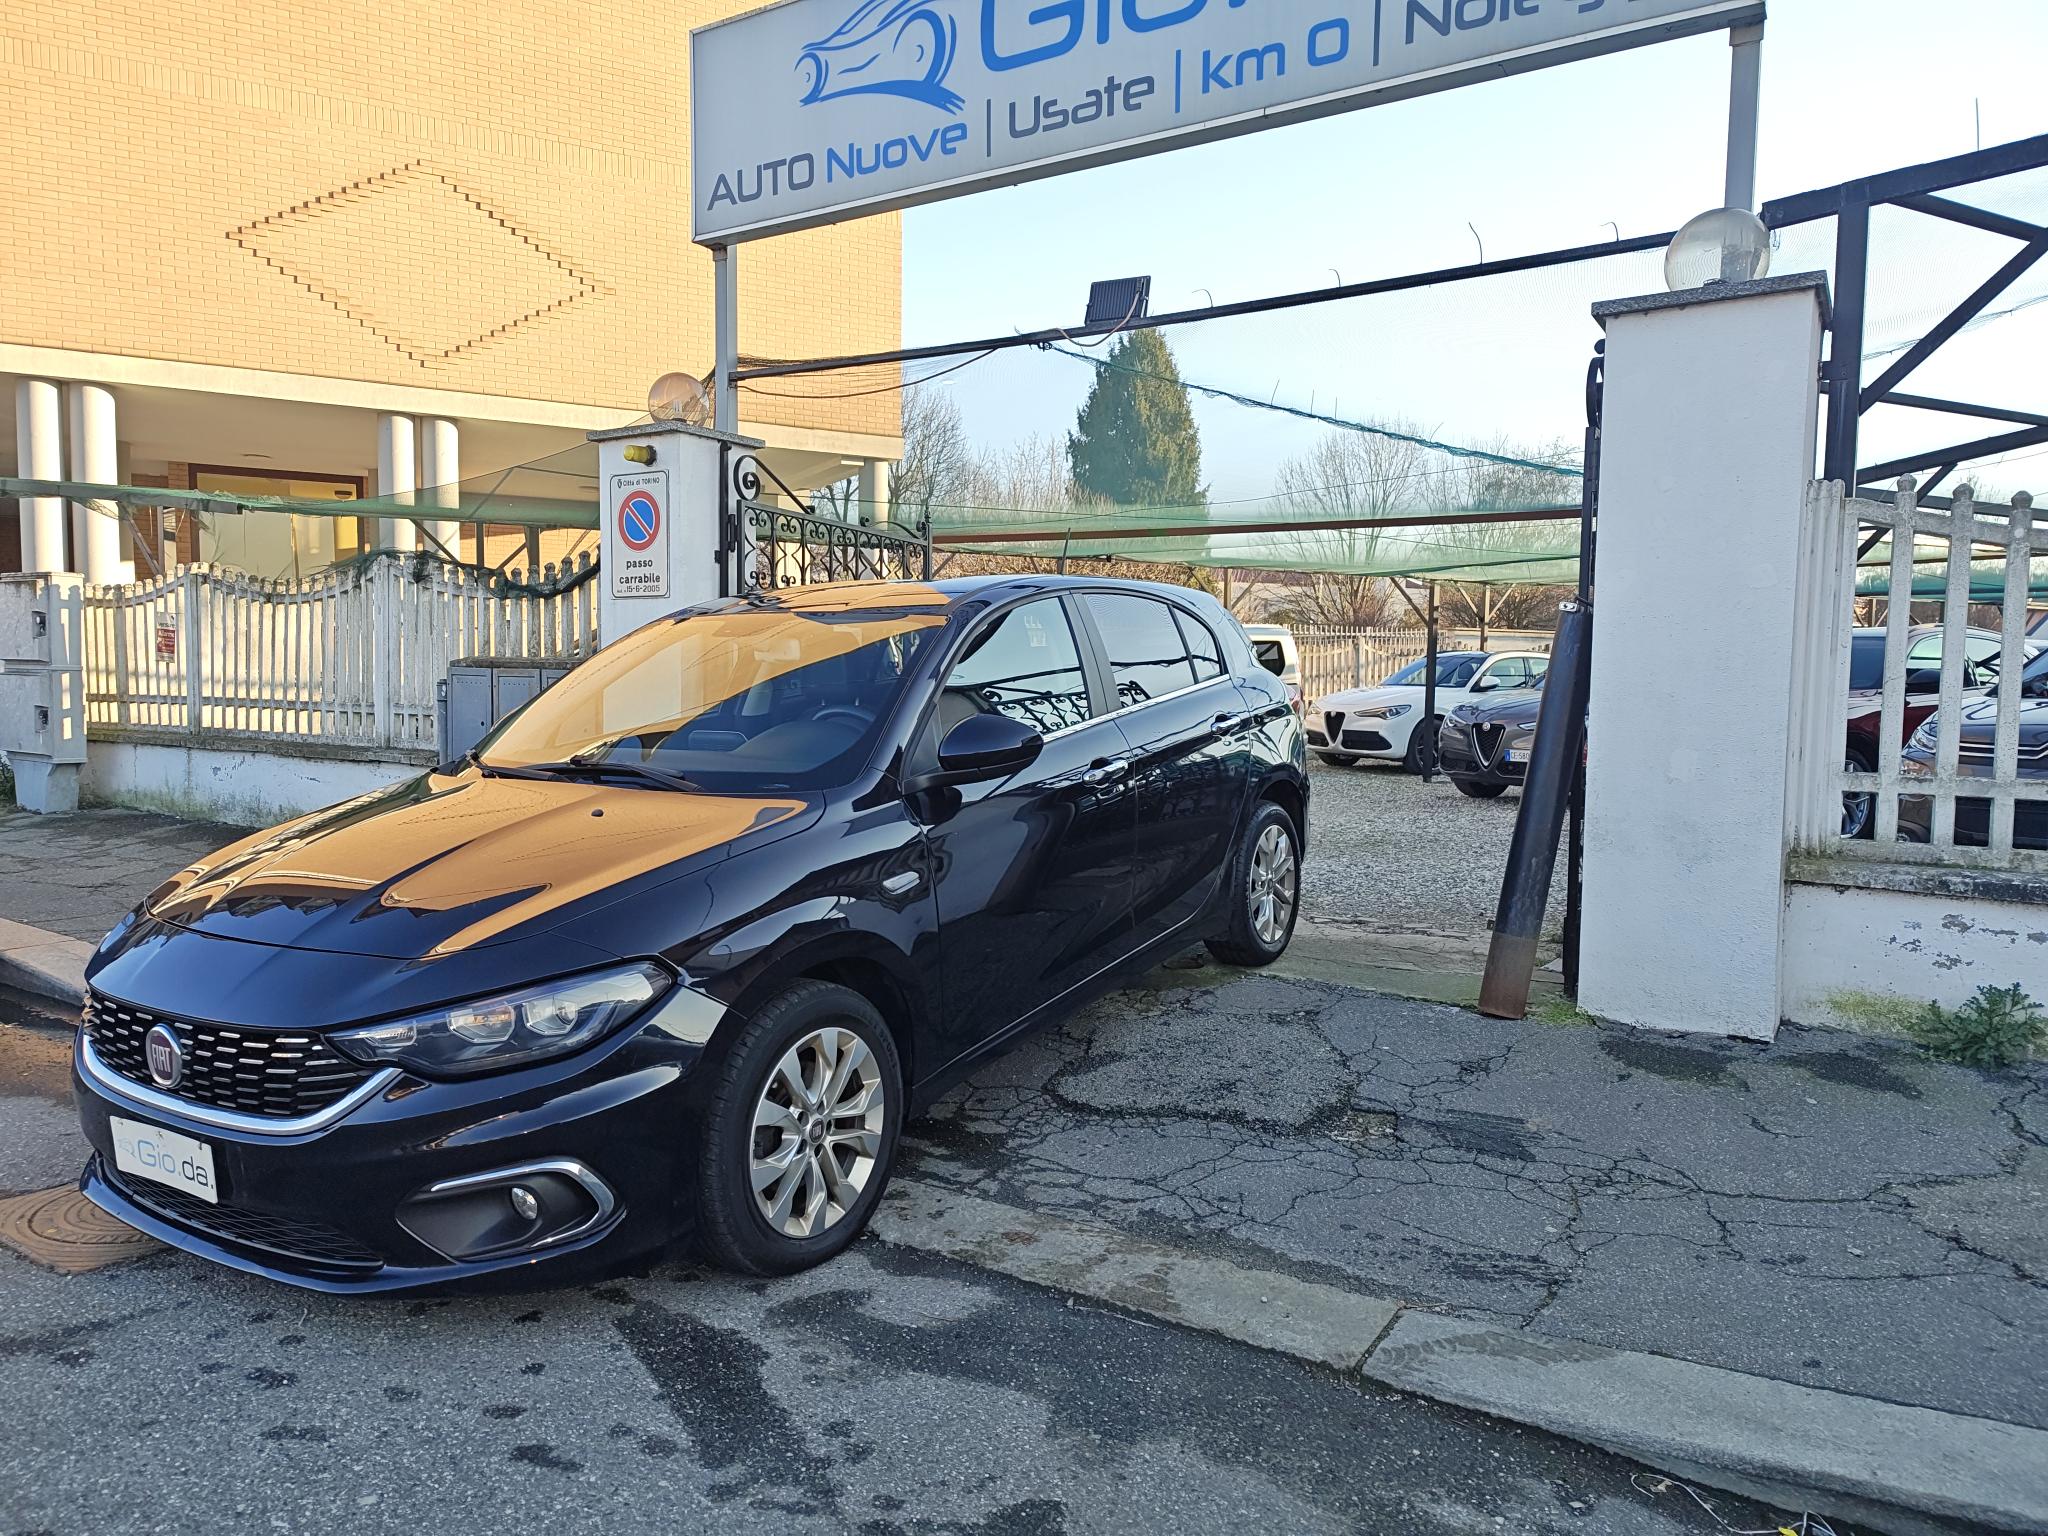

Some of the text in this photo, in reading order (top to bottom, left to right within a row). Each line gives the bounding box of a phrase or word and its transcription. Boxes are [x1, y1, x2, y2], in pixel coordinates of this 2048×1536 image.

[707, 152, 815, 212] AUTO
[826, 122, 968, 184] Nuove
[1008, 75, 1156, 140] Usate
[1201, 41, 1287, 95] km
[641, 477, 660, 485] TORINO
[626, 559, 653, 570] passo
[619, 573, 661, 584] carrabile
[151, 1044, 171, 1073] FIAT
